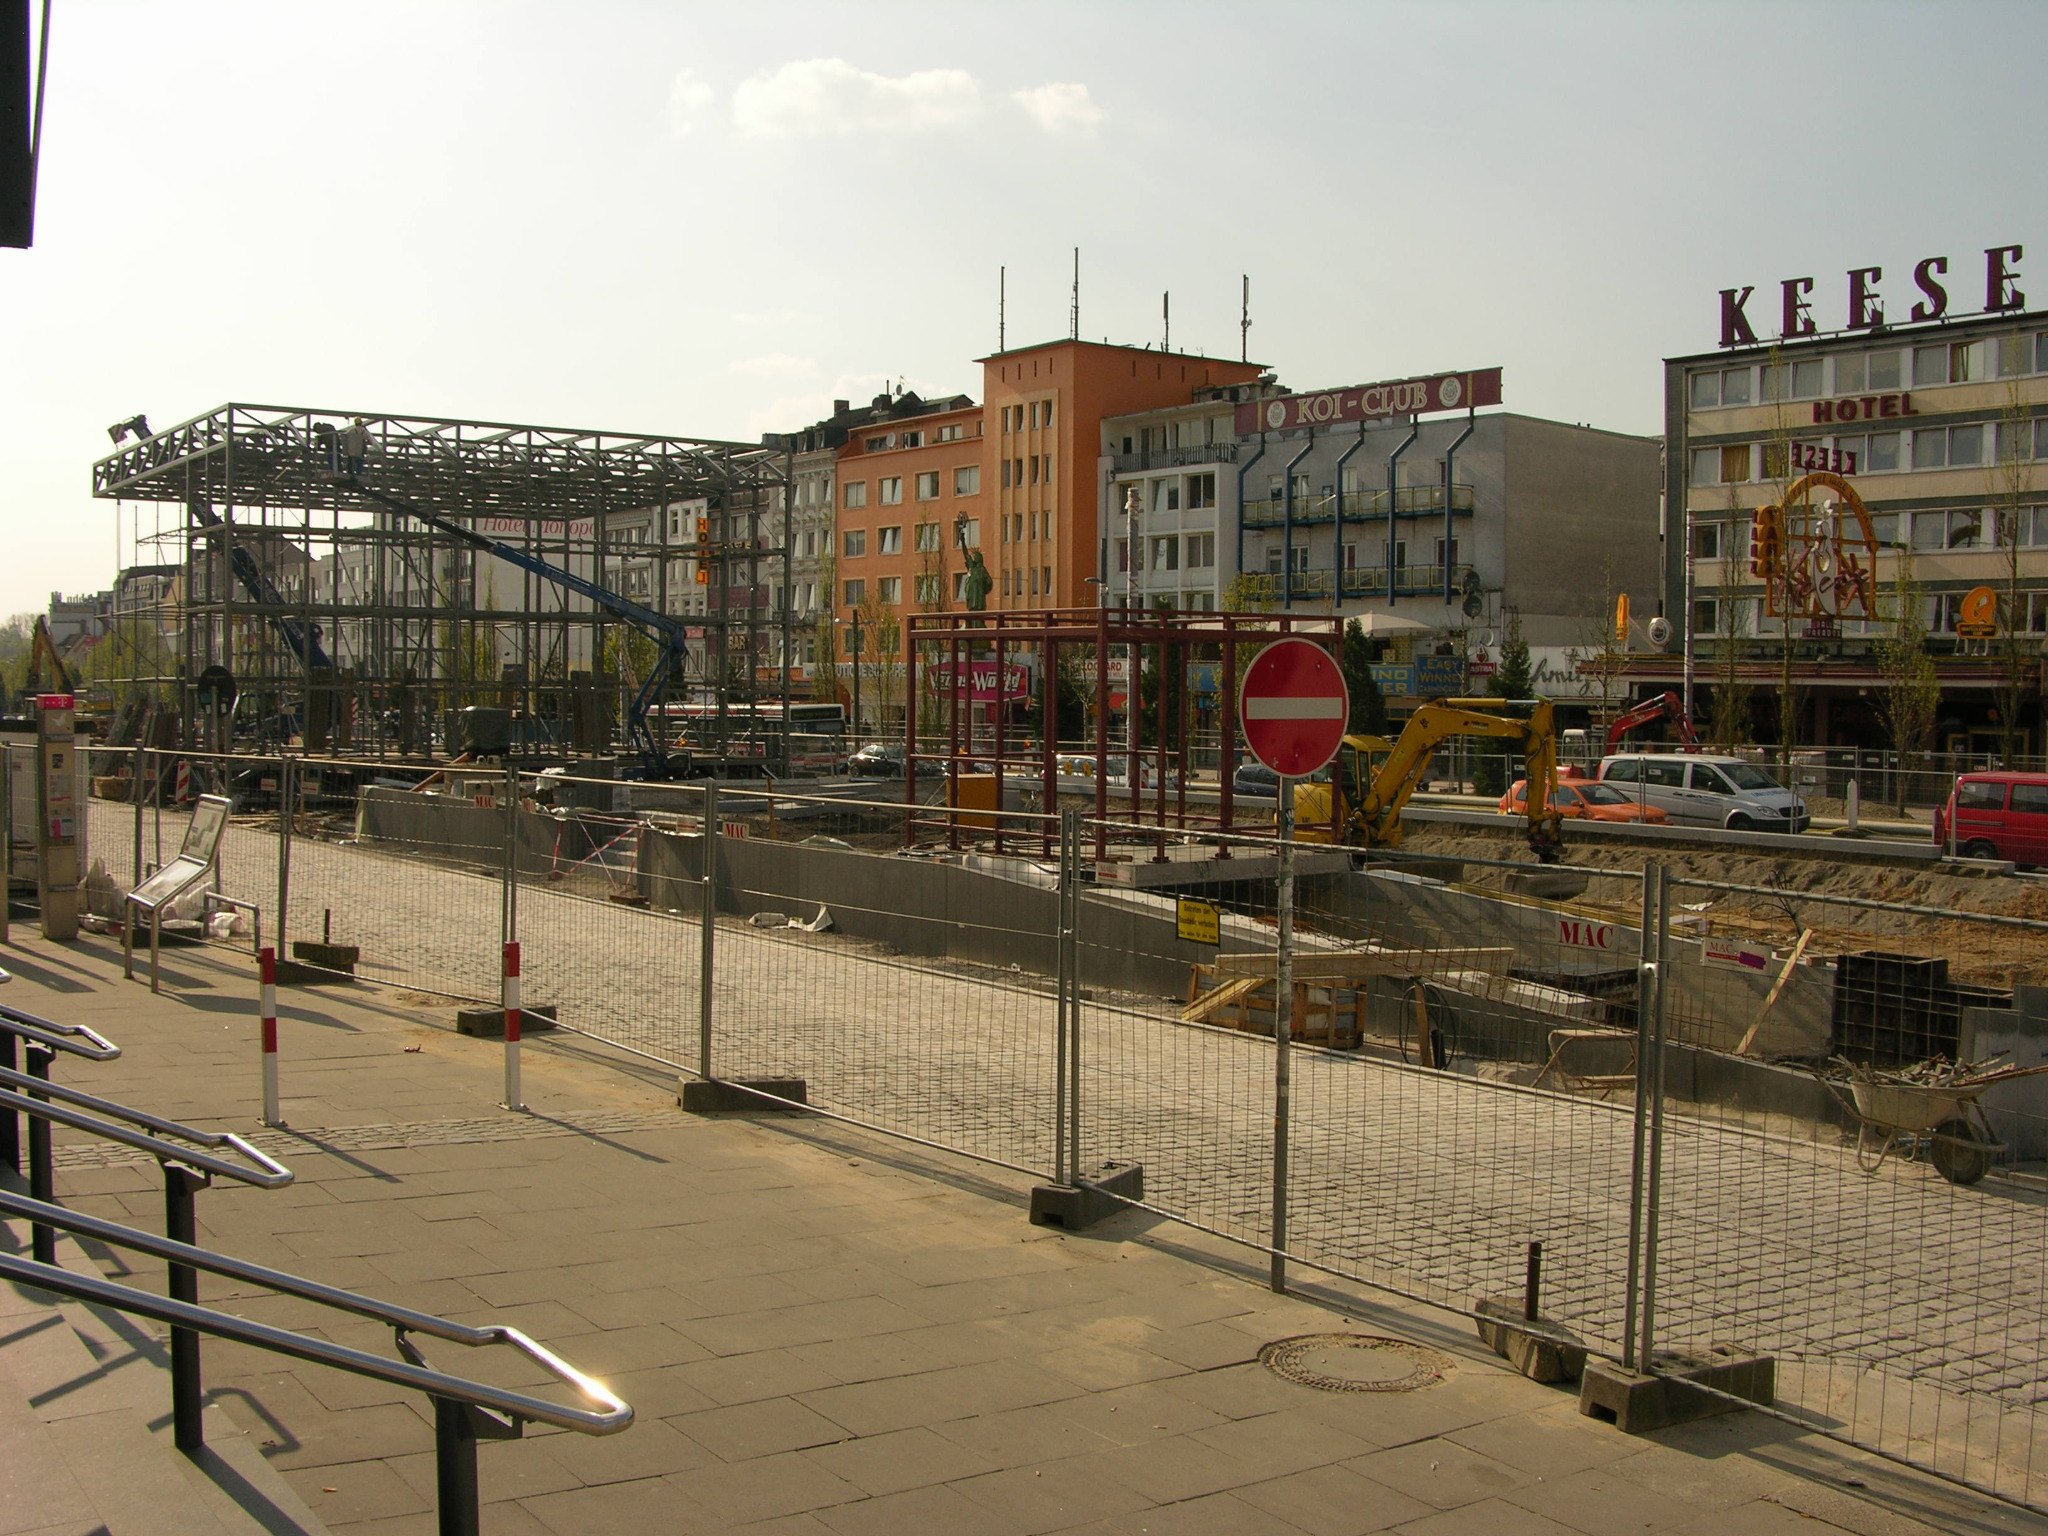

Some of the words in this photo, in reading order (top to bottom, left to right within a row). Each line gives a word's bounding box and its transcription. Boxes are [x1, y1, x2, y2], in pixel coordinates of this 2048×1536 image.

[1718, 244, 2026, 348] KEESE
[1812, 392, 1919, 424] HOTEL
[728, 635, 746, 650] BAR
[1470, 665, 1493, 673] ASTRA
[1419, 671, 1463, 684] WINNE
[475, 795, 494, 808] MAC
[726, 823, 747, 839] MAC
[1559, 920, 1614, 949] MAC
[1709, 942, 1733, 953] MAC
